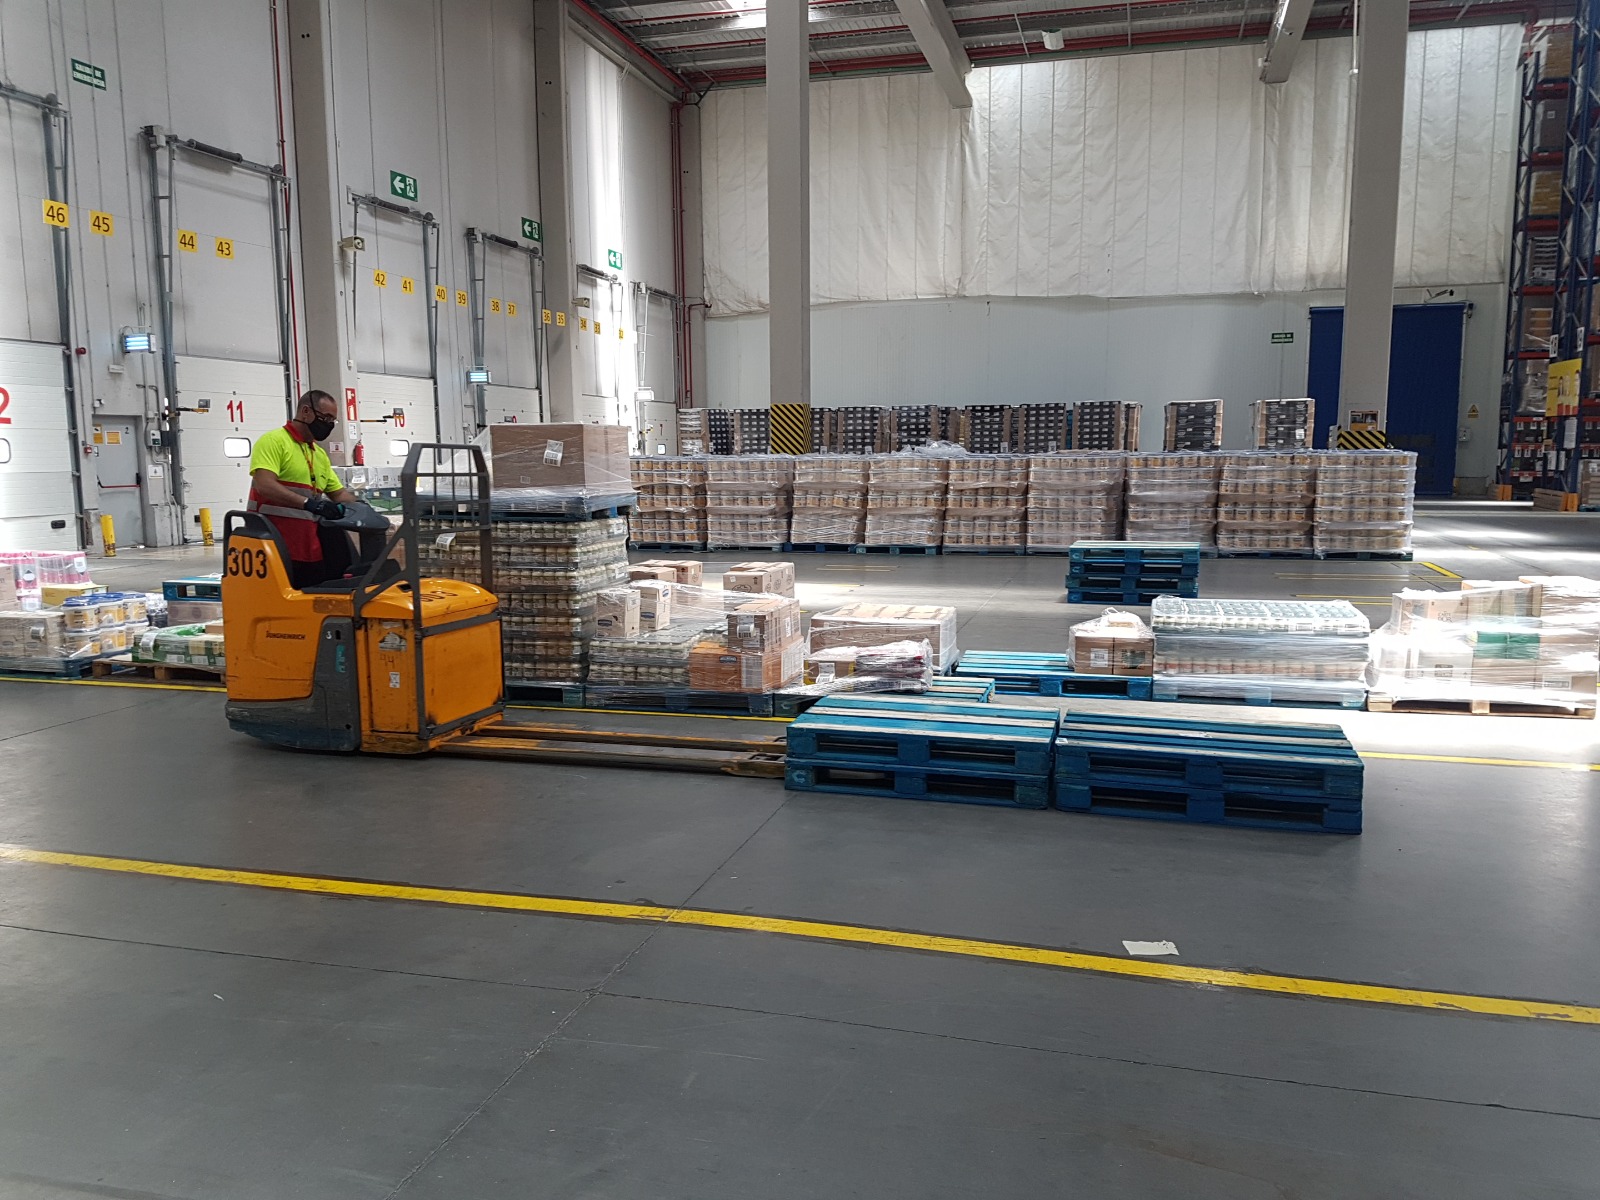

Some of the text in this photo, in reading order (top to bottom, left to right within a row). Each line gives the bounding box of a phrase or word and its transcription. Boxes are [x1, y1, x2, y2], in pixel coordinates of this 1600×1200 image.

[46, 205, 66, 223] 46
[92, 215, 110, 233] 45
[179, 233, 195, 249] 44
[217, 241, 231, 256] 43
[375, 272, 386, 286] 42
[402, 280, 412, 292] 41
[436, 288, 446, 300] 40
[457, 292, 466, 305] 39
[491, 300, 500, 312] 38
[507, 304, 515, 315] 37
[543, 311, 551, 322] 36
[557, 314, 564, 325] 35
[226, 399, 244, 423] 11
[124, 426, 130, 435] 2
[228, 547, 267, 579] 303
